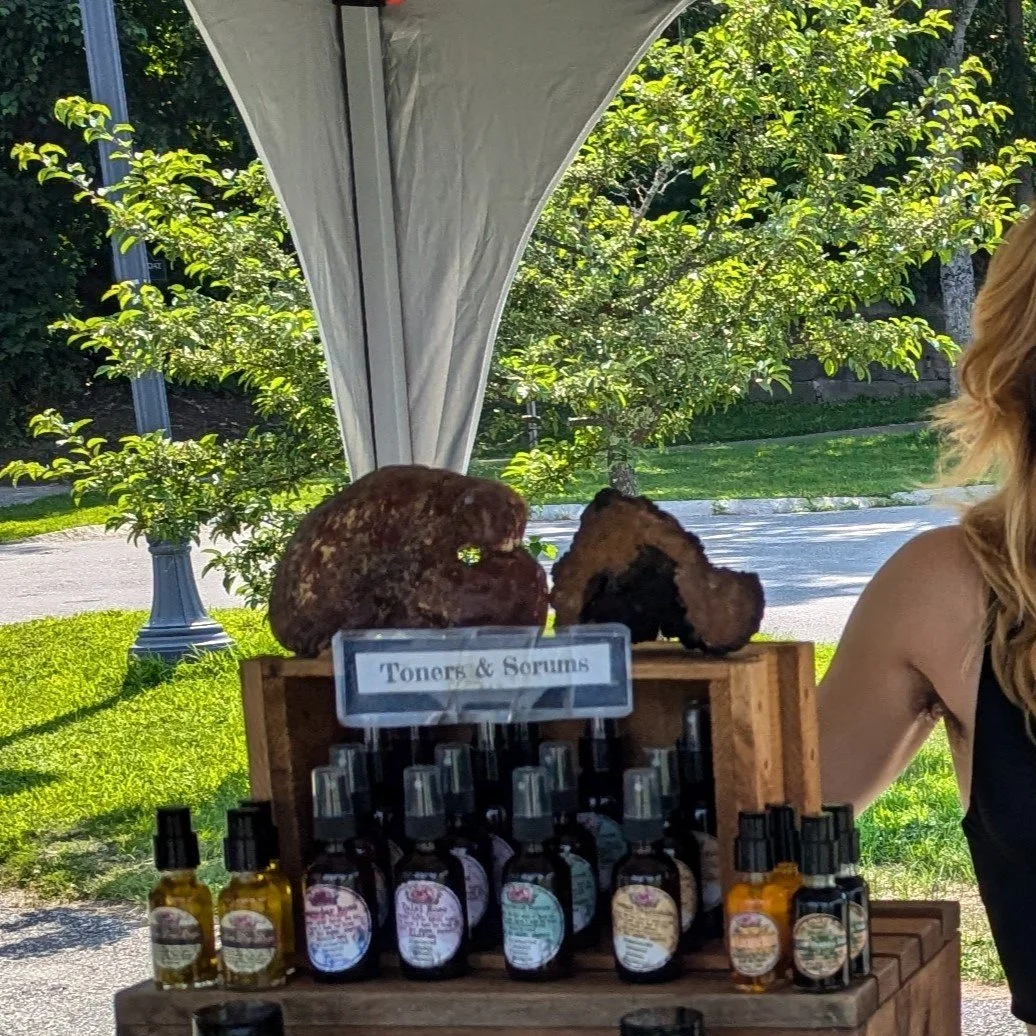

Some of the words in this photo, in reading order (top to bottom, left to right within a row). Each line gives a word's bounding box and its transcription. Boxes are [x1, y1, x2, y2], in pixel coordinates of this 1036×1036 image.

[380, 661, 467, 684] Toners
[475, 656, 494, 678] &
[502, 655, 590, 677] Serums
